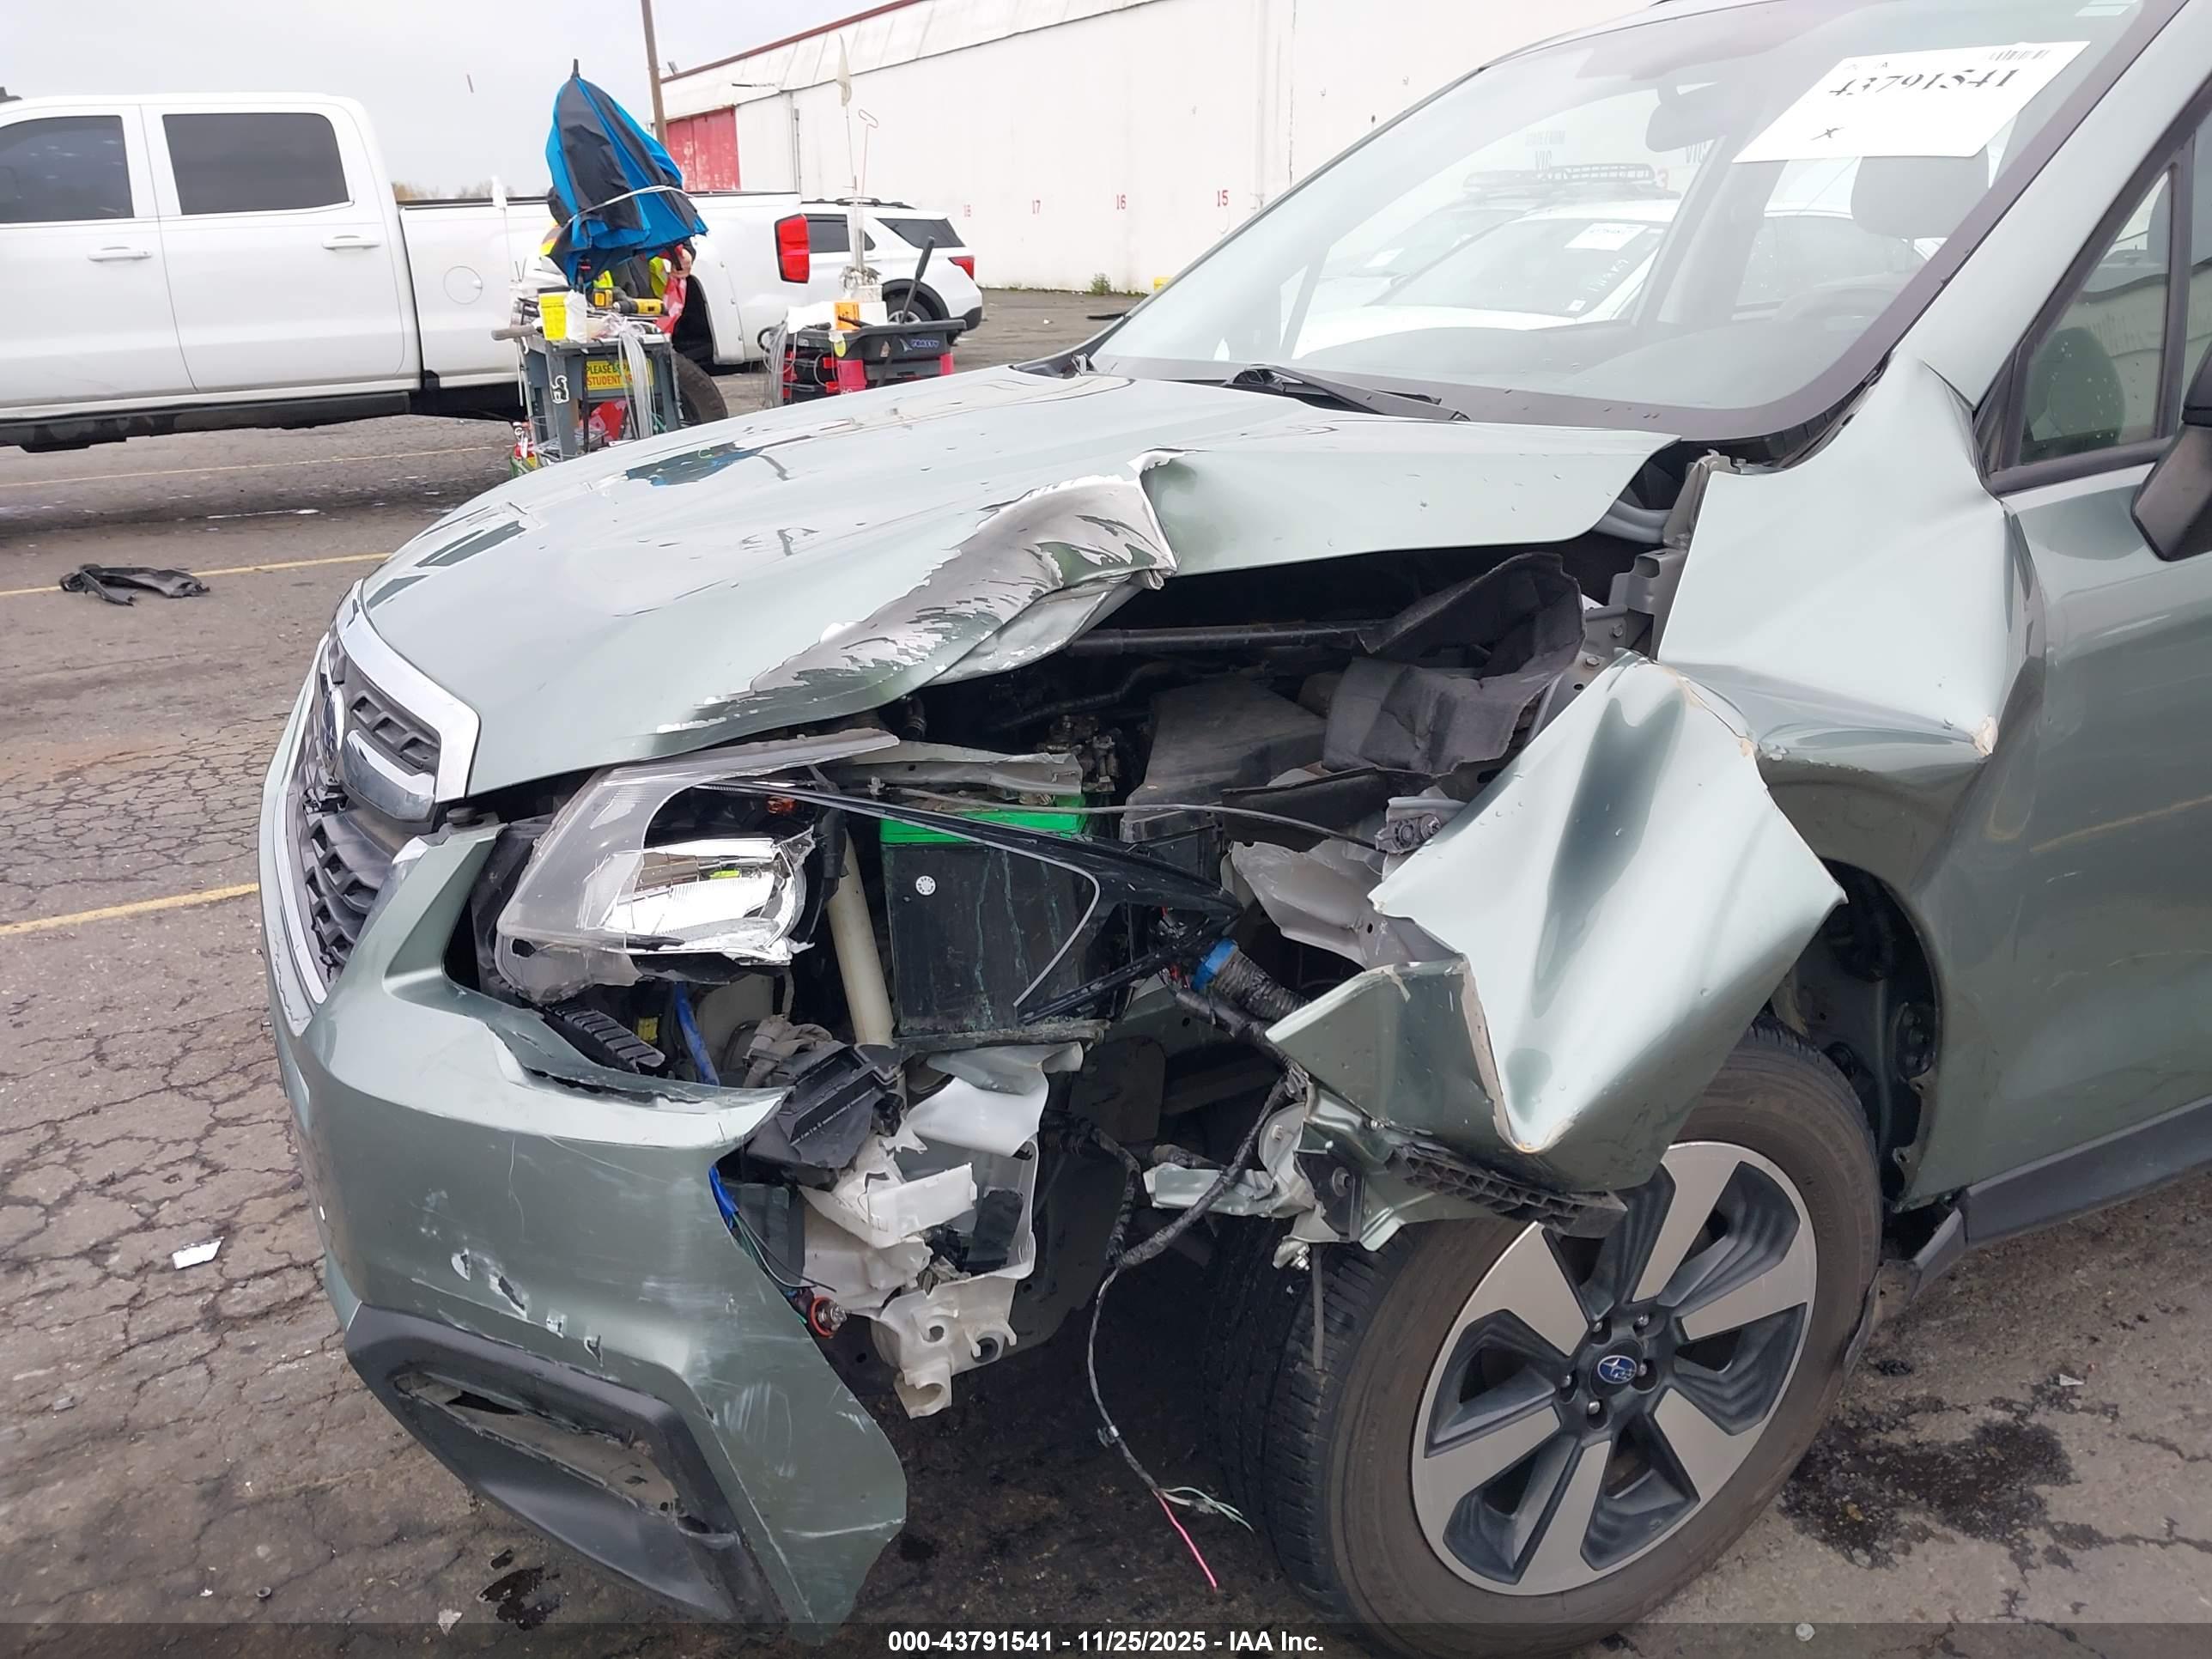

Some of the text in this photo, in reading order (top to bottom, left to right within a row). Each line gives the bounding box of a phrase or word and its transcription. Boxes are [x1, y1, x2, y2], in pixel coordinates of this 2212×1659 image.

[1116, 194, 1127, 210] 16
[1217, 190, 1229, 207] 15
[1031, 199, 1042, 214] 17
[586, 375, 621, 386] STUDENT
